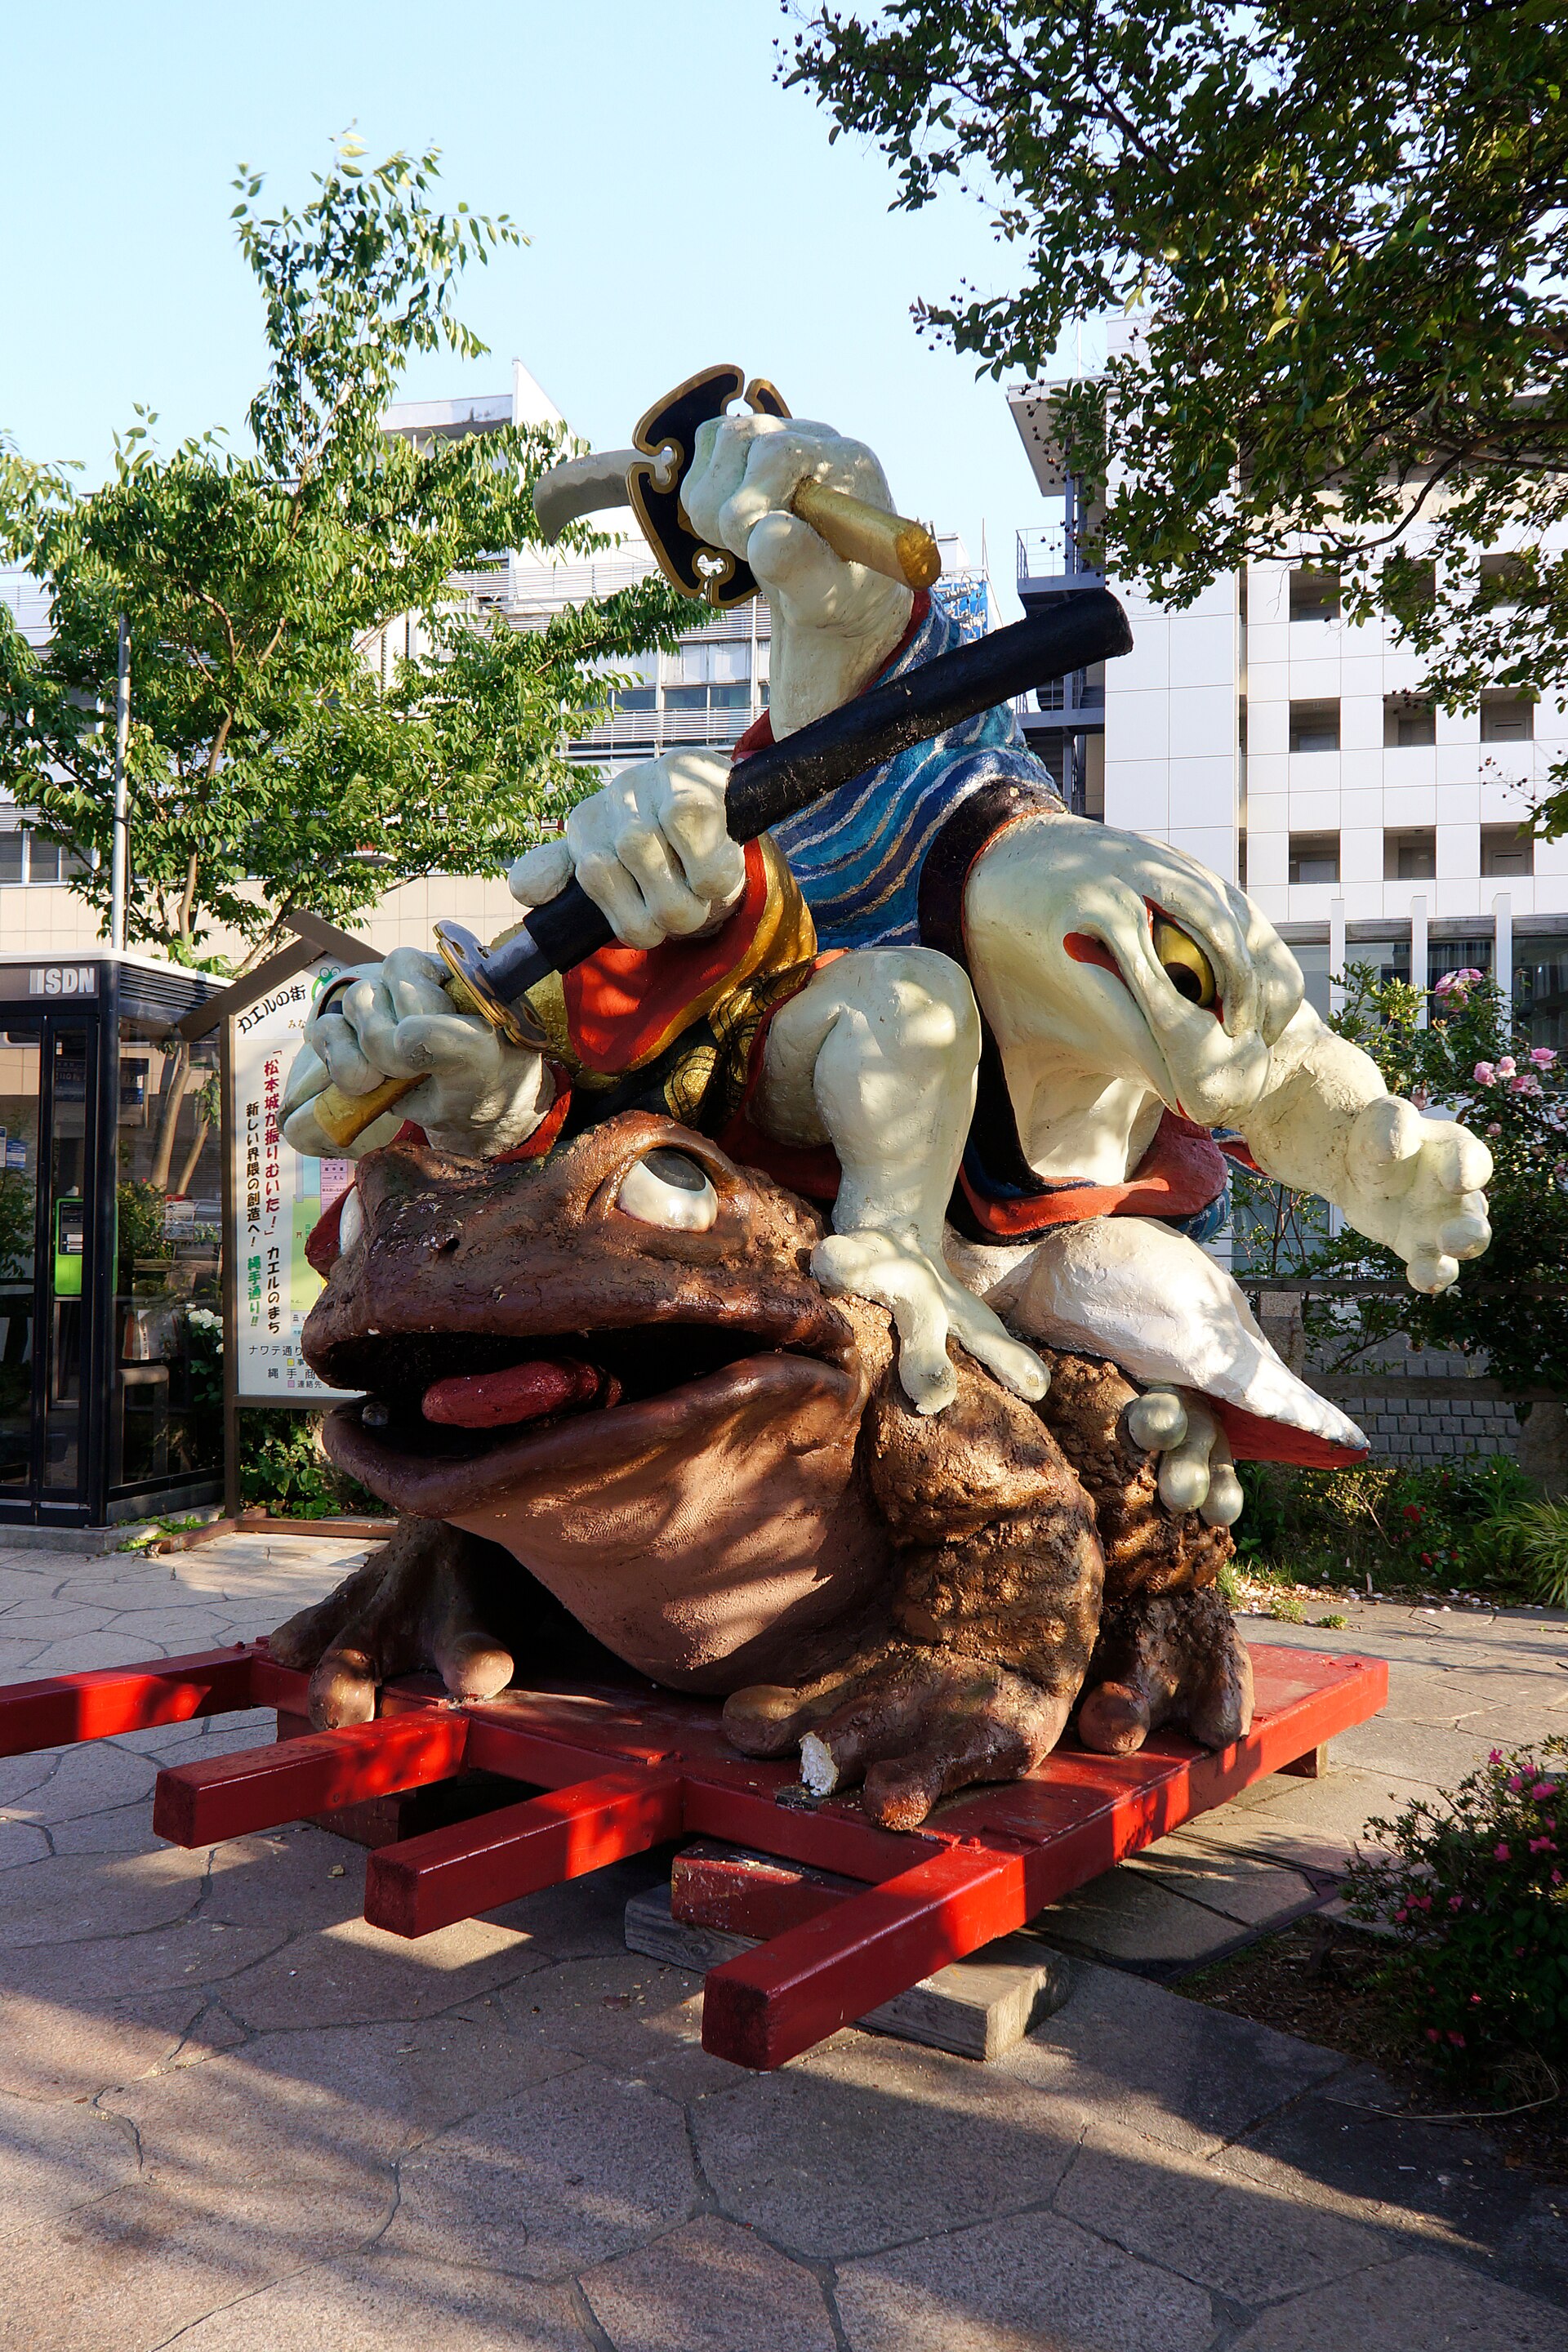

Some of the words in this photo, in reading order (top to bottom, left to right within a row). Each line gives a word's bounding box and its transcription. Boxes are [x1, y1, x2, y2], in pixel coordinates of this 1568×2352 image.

[29, 968, 95, 994] ISDN
[237, 984, 305, 1034] カエルの街
[267, 1246, 281, 1334] カエルのまち
[248, 1345, 302, 1356] ナワテ通り
